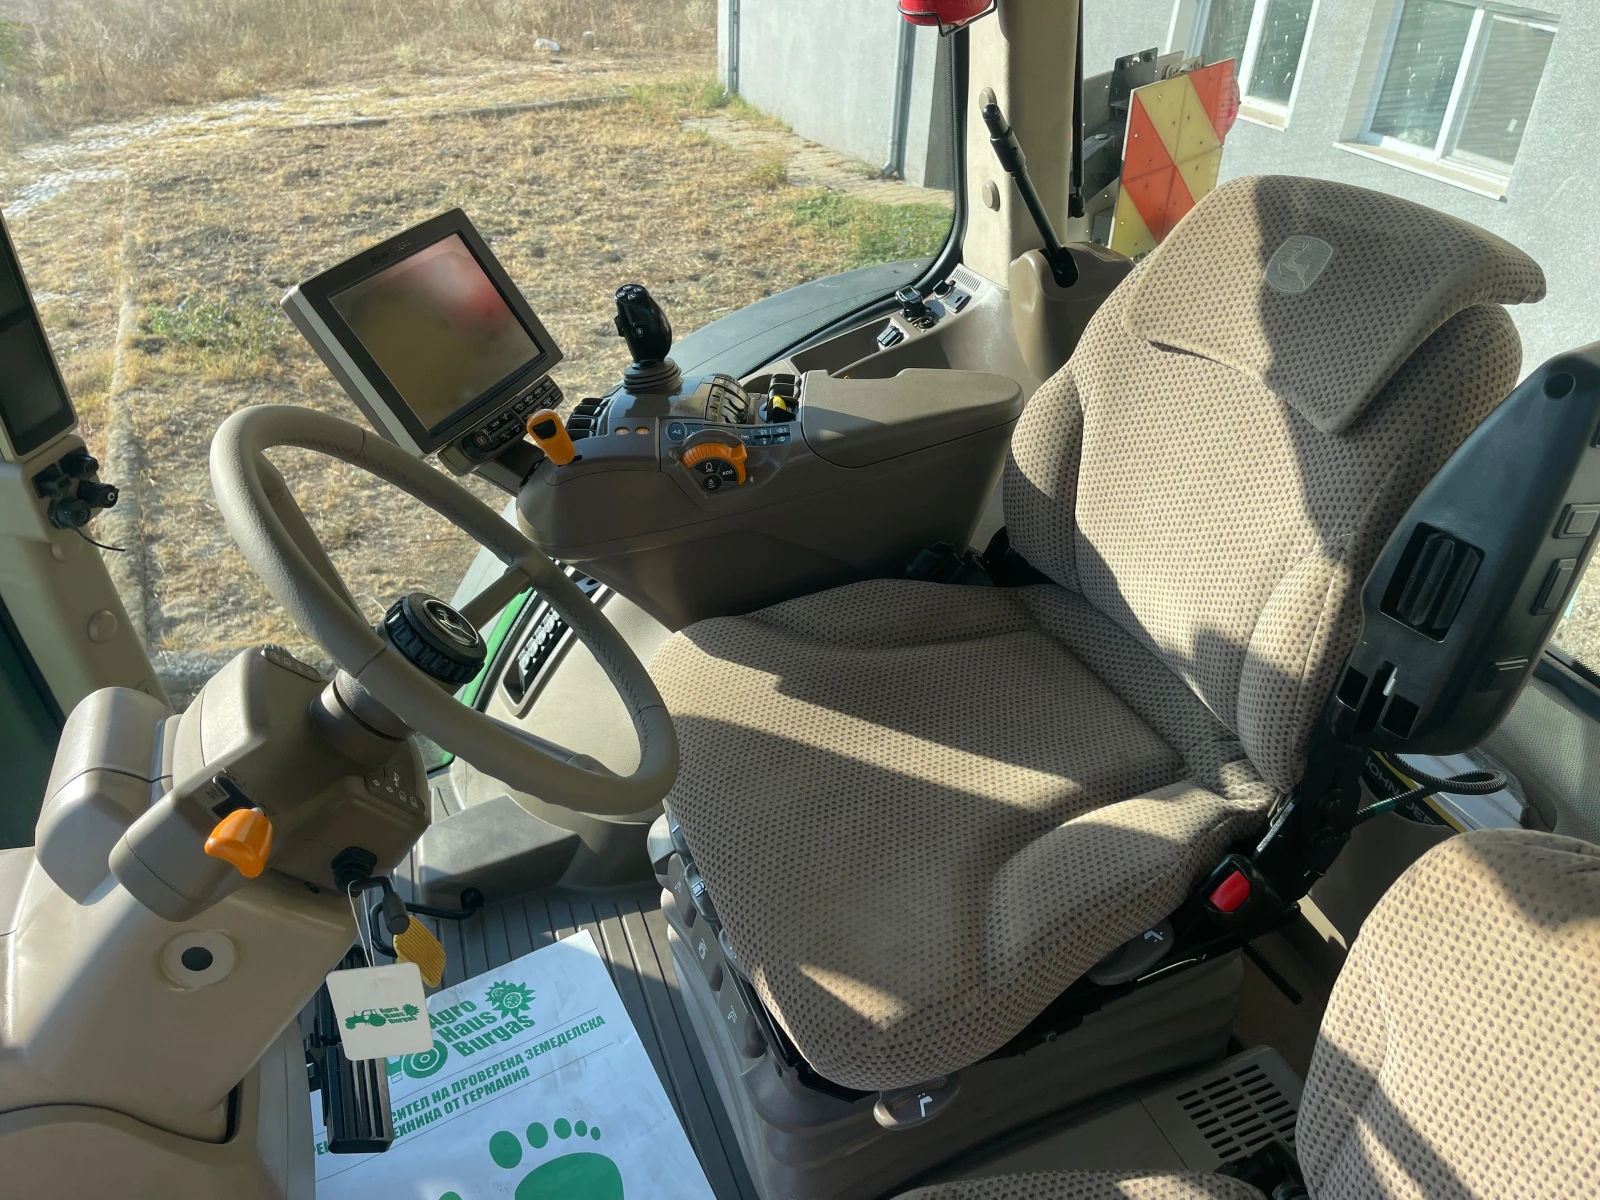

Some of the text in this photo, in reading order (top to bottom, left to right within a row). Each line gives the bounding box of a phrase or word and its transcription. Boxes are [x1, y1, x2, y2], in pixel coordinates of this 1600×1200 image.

[1365, 756, 1400, 796] JOHN
[428, 1000, 477, 1029] Agro
[436, 1011, 498, 1043] Haus
[452, 1015, 536, 1057] Burgas
[391, 1015, 606, 1124] СИТЕЛ НА ПРОВЕРЕНА ЗЕМЕДЕЛСКА
[393, 1066, 530, 1140] ЕХНИКА ОТ ГЕРМАНИЯ
